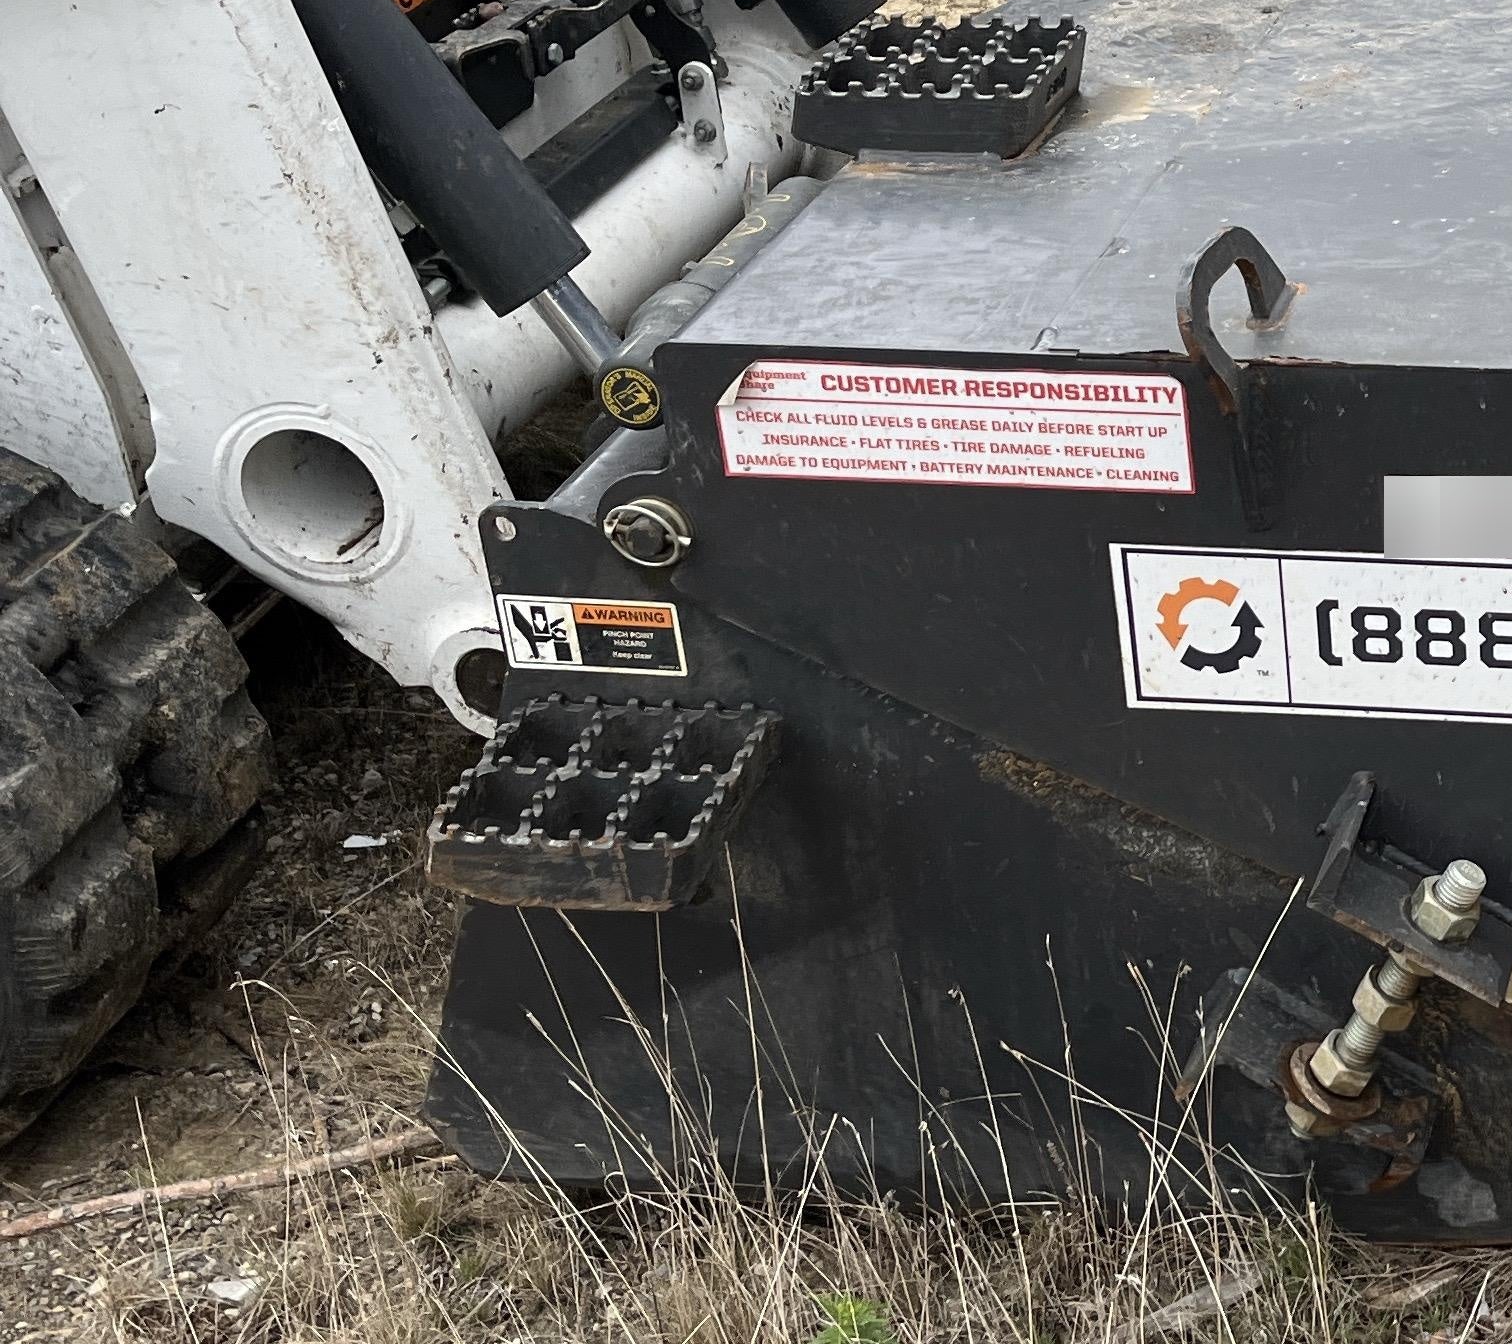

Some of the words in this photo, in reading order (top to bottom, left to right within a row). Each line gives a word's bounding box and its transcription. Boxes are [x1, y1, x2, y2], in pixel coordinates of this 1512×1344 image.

[744, 368, 807, 381] quipment
[820, 374, 959, 396] CUSTOMER
[964, 379, 1178, 404] RESPONSIBILITY
[736, 410, 783, 424] CHECK
[787, 412, 812, 425] ALL
[815, 413, 859, 427] FLUID
[862, 415, 914, 429] LEVELS
[917, 418, 927, 429] &
[931, 418, 988, 432] GREASE
[992, 420, 1034, 433] DAILY
[1038, 422, 1094, 435] BEFORE
[1098, 424, 1144, 437] START
[1148, 427, 1168, 438] UP
[762, 433, 848, 448] INSURANCE
[859, 437, 892, 449] FLAT
[896, 439, 941, 451] TIRES
[951, 440, 986, 453] TIRE
[990, 442, 1051, 455] DAMAGE
[1064, 445, 1146, 460] REFUELING
[736, 453, 797, 467] DAMAGE
[801, 455, 818, 468] TO
[822, 457, 908, 471] EQUIPMENT
[920, 461, 983, 474] BATTERY
[987, 464, 1094, 479] MAINTENANCE
[1106, 468, 1180, 482] CLEANING
[594, 608, 665, 623] WARNING
[602, 629, 629, 638] PINCH
[630, 631, 654, 640] POINT
[613, 639, 648, 648] HAZARD
[612, 650, 633, 659] Keep
[633, 652, 653, 660] clear
